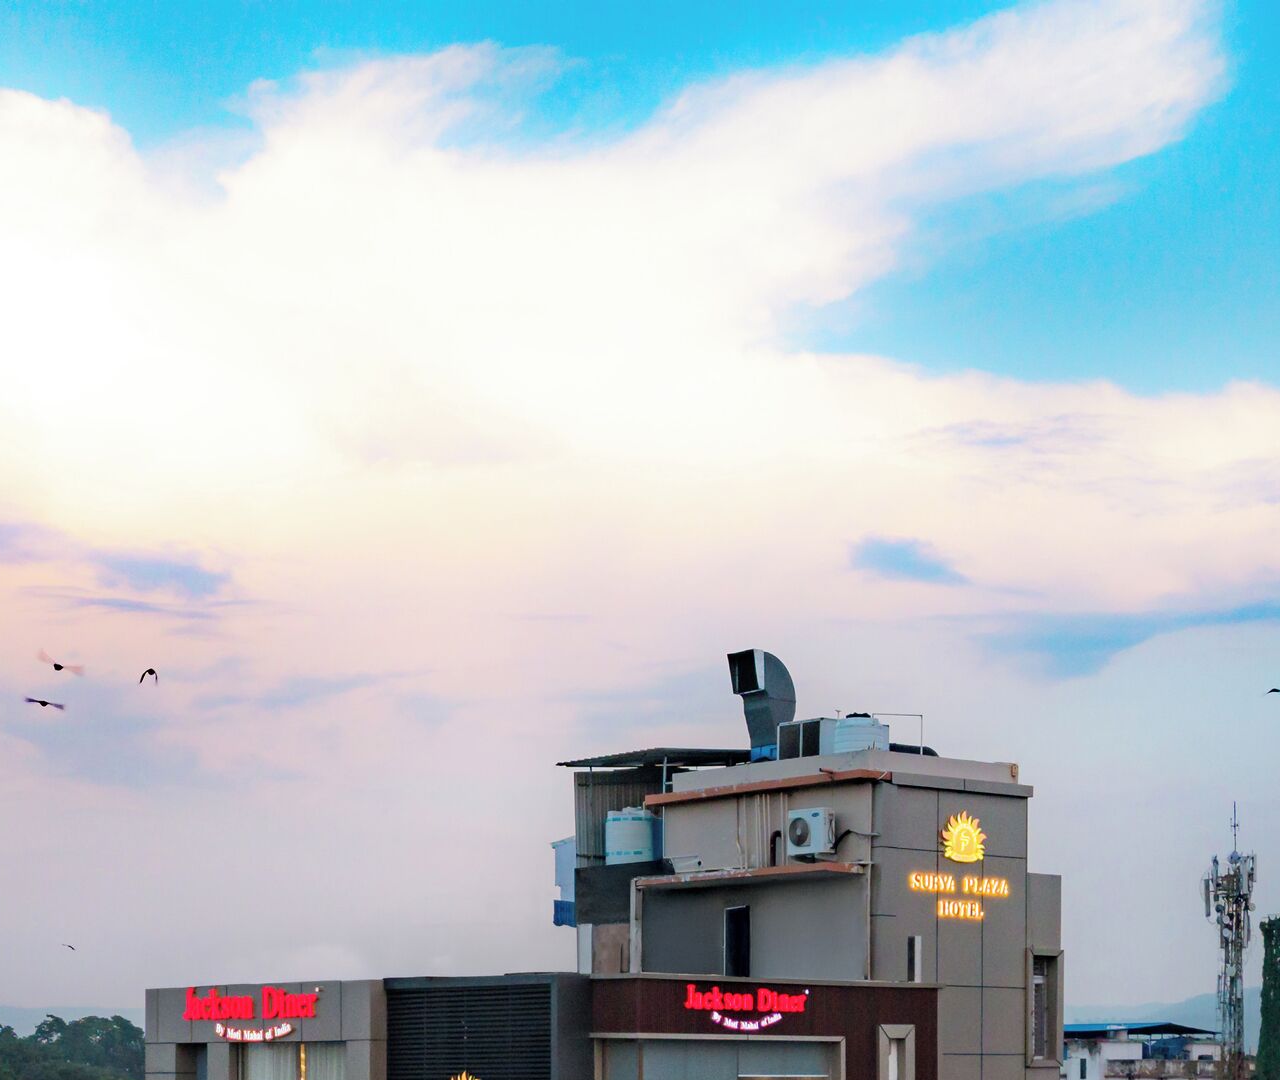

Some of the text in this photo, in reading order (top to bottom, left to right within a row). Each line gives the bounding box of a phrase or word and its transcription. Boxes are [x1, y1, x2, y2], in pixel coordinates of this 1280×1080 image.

[910, 872, 1009, 896] SURYA PLAZA
[938, 900, 984, 918] HOTEL
[183, 985, 318, 1021] Jackson Diner
[684, 984, 807, 1013] Jackson Diner
[215, 1023, 292, 1041] By Moti Mahal of India
